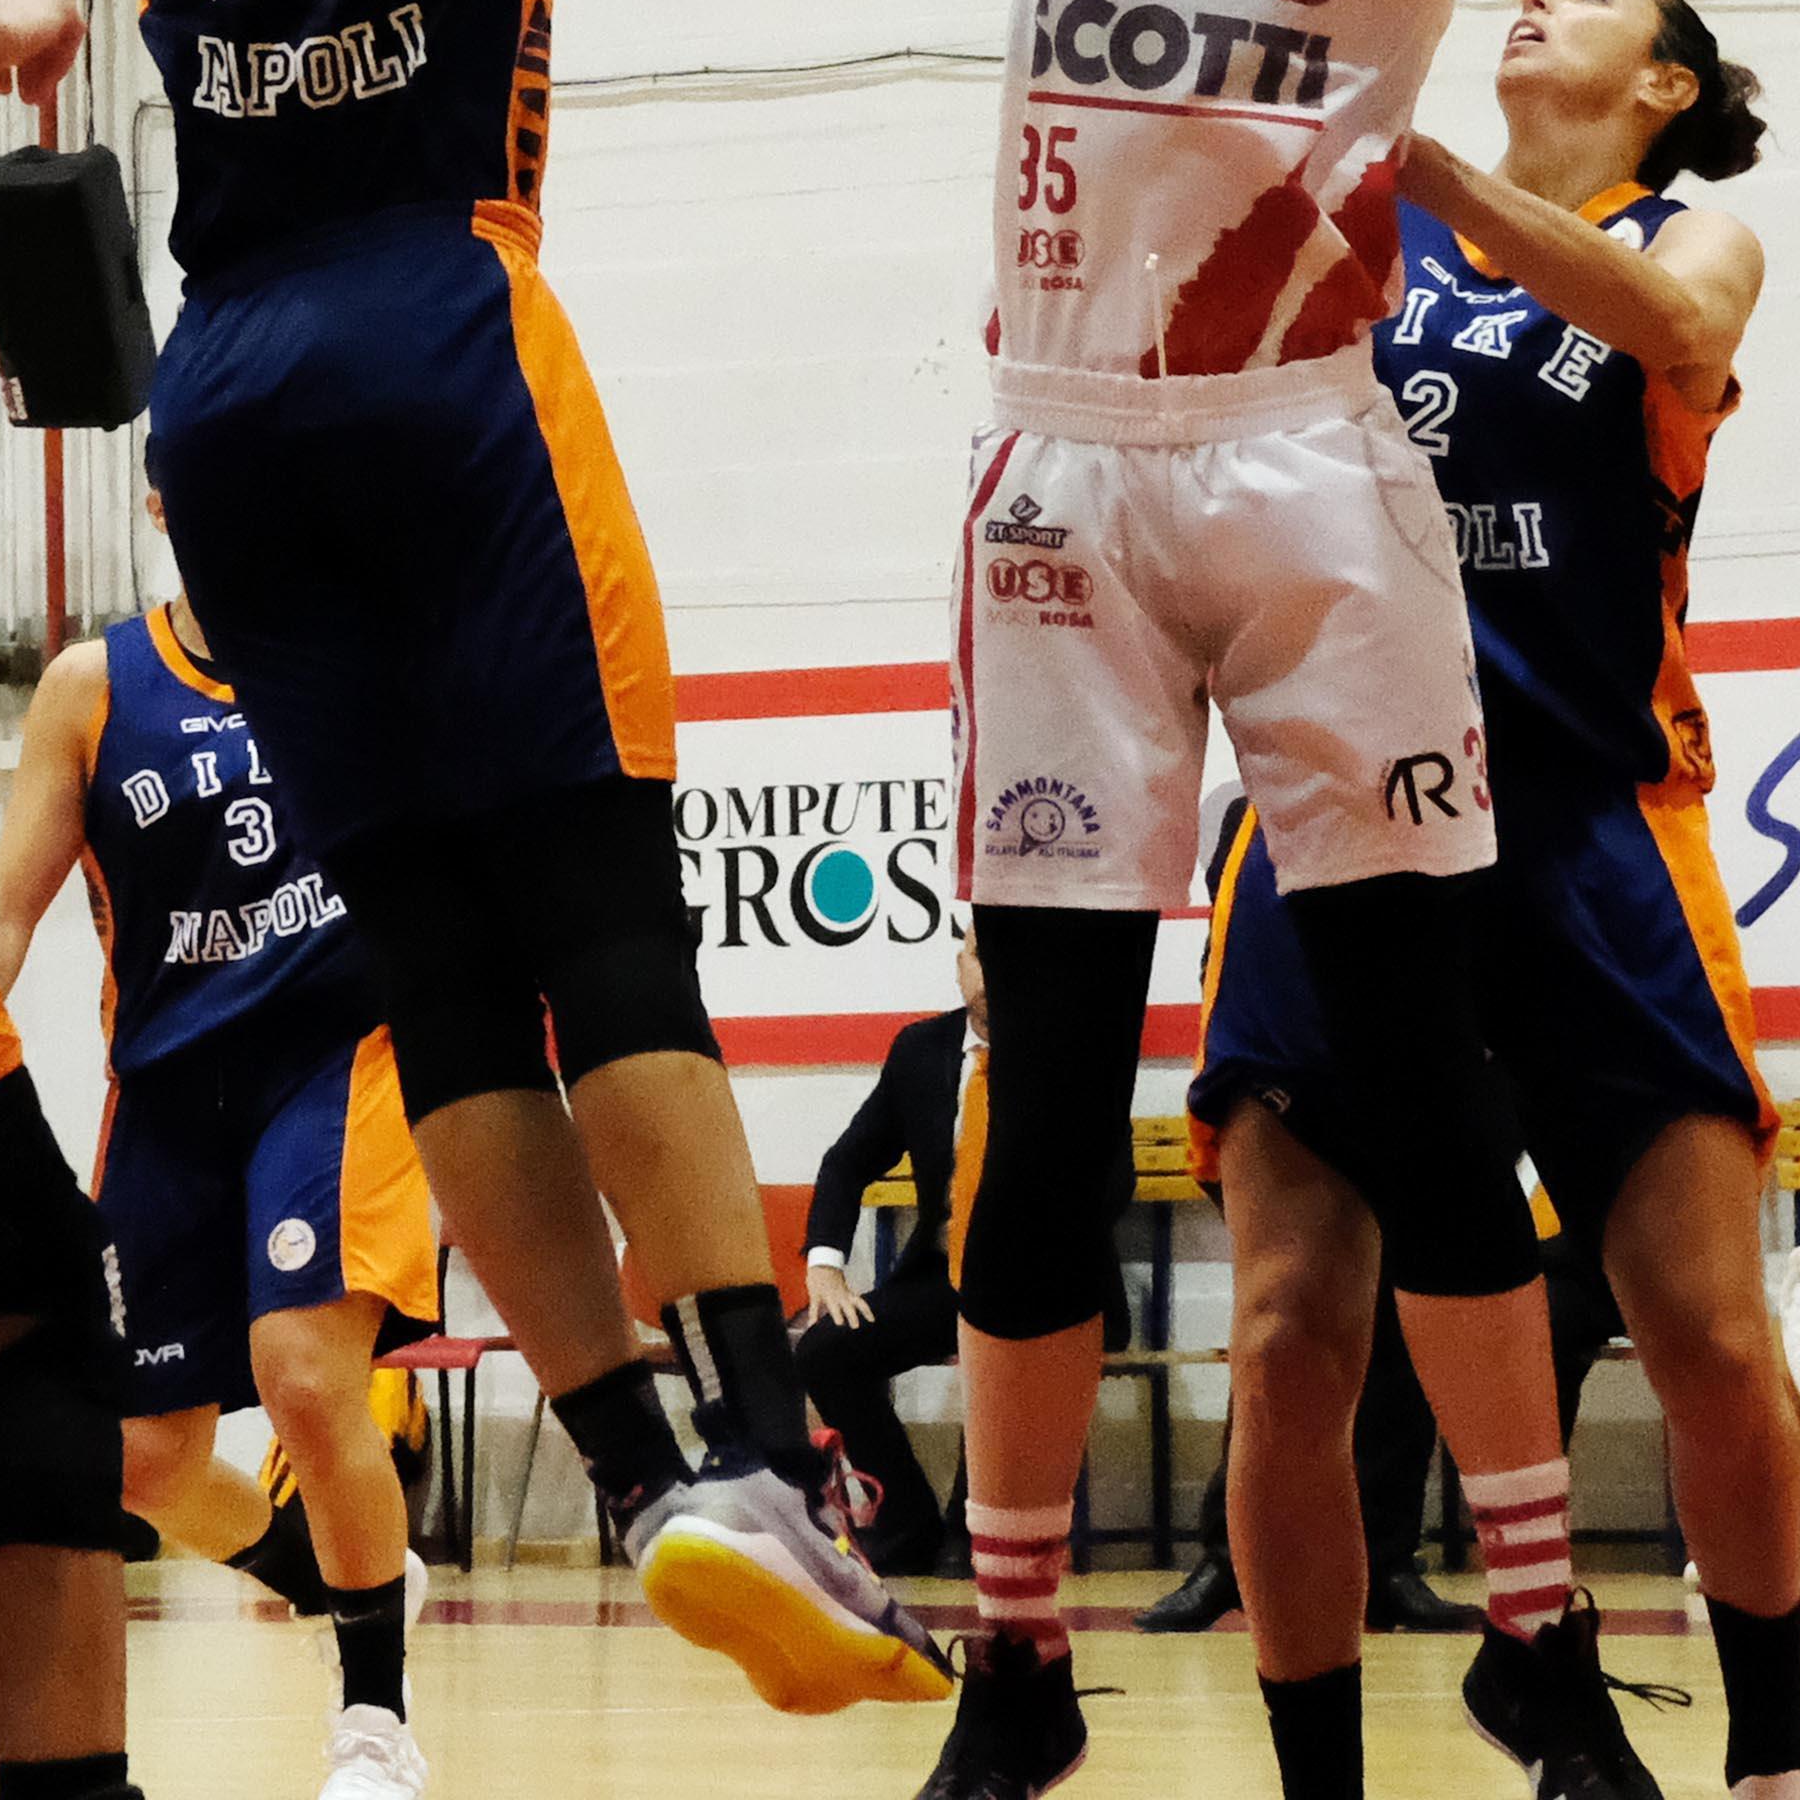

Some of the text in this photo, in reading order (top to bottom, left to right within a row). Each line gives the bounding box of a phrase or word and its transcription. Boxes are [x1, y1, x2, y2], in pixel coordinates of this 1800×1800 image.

[1392, 287, 1612, 402] IKE
[987, 558, 1094, 606] USE
[225, 796, 277, 867] 3
[673, 778, 948, 841] OMPUTE
[985, 777, 1101, 835] SAMMONTANA
[164, 872, 348, 965] NAPOL
